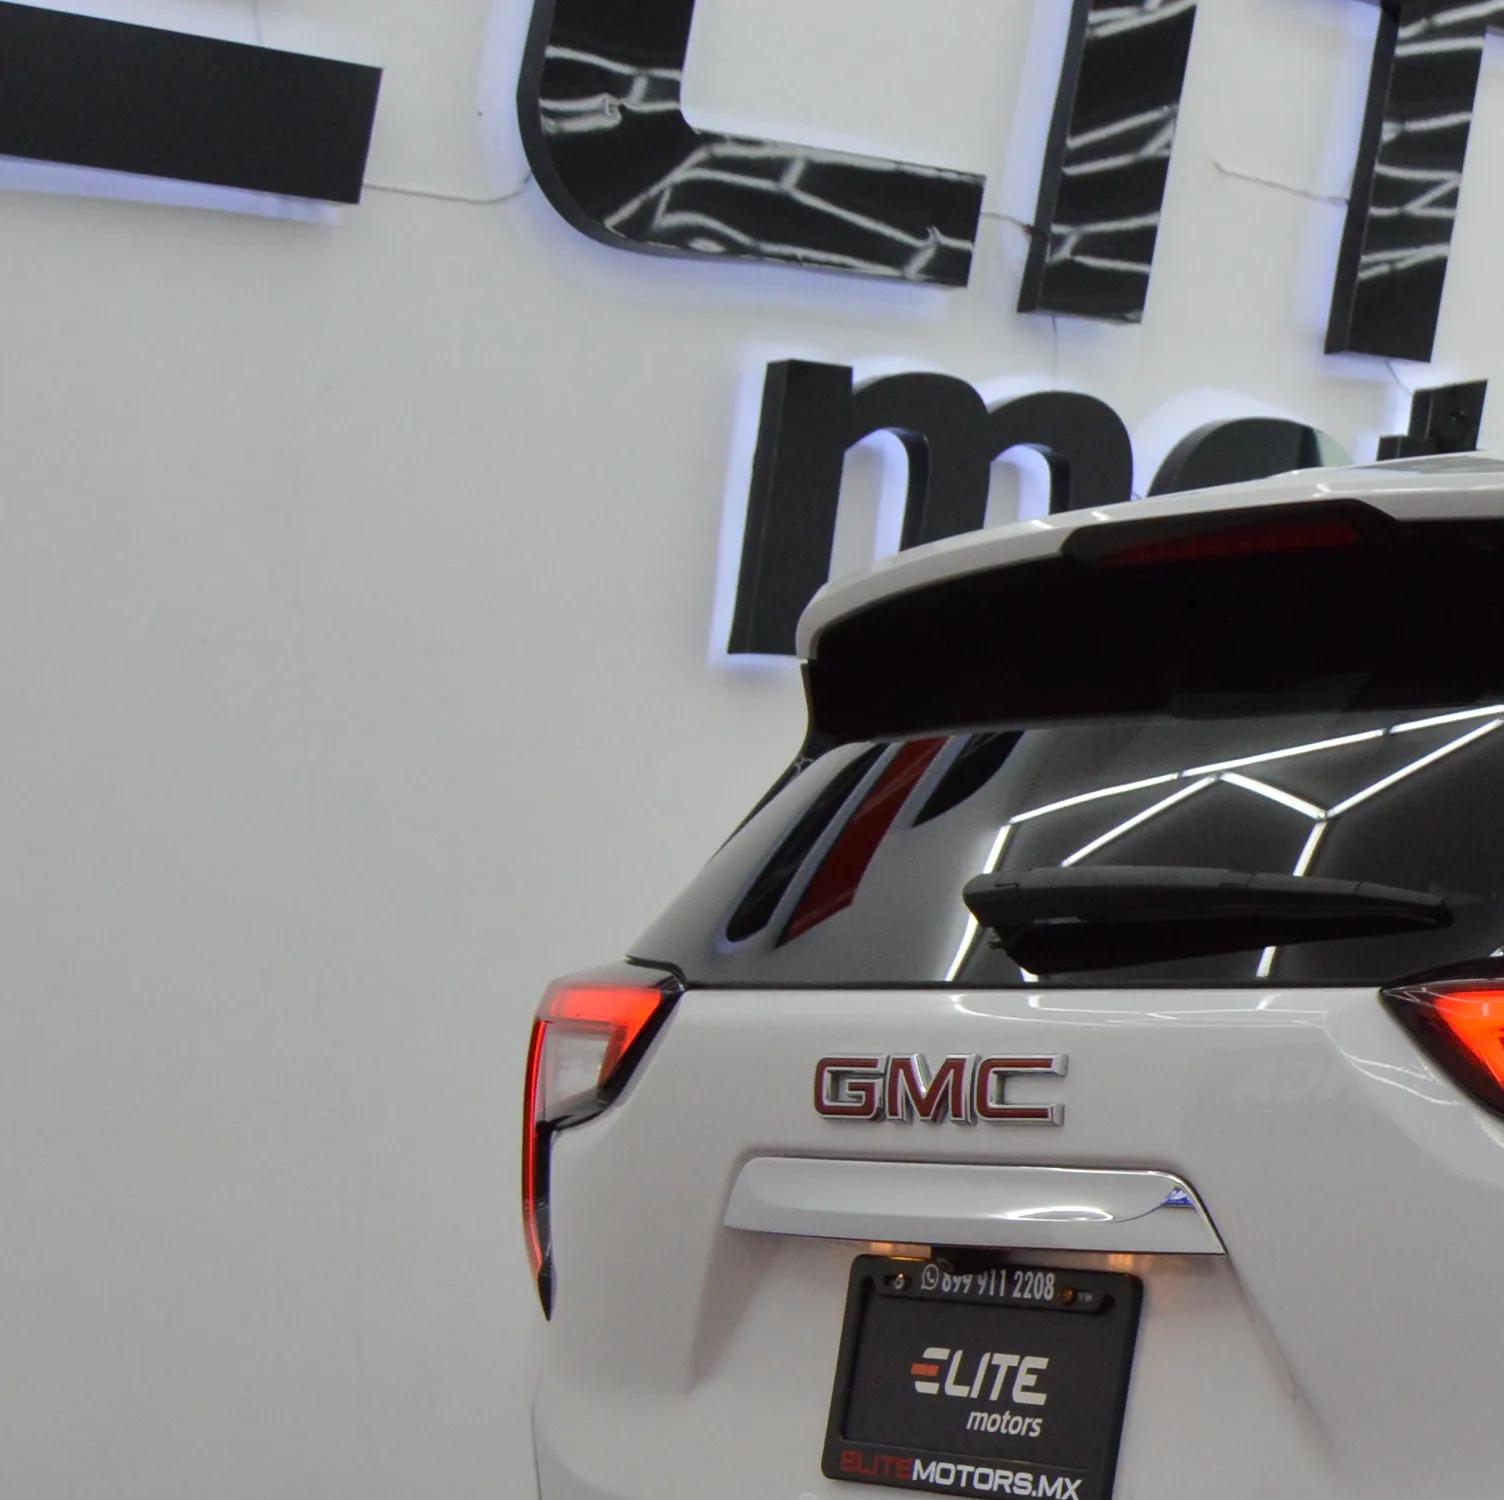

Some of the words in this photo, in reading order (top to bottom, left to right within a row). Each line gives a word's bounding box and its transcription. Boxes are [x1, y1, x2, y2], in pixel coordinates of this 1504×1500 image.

[813, 1053, 1069, 1127] GMC
[977, 1269, 1007, 1297] 911
[1013, 1271, 1056, 1301] 2208
[911, 1347, 1049, 1406] ELITE
[966, 1409, 1043, 1438] motors
